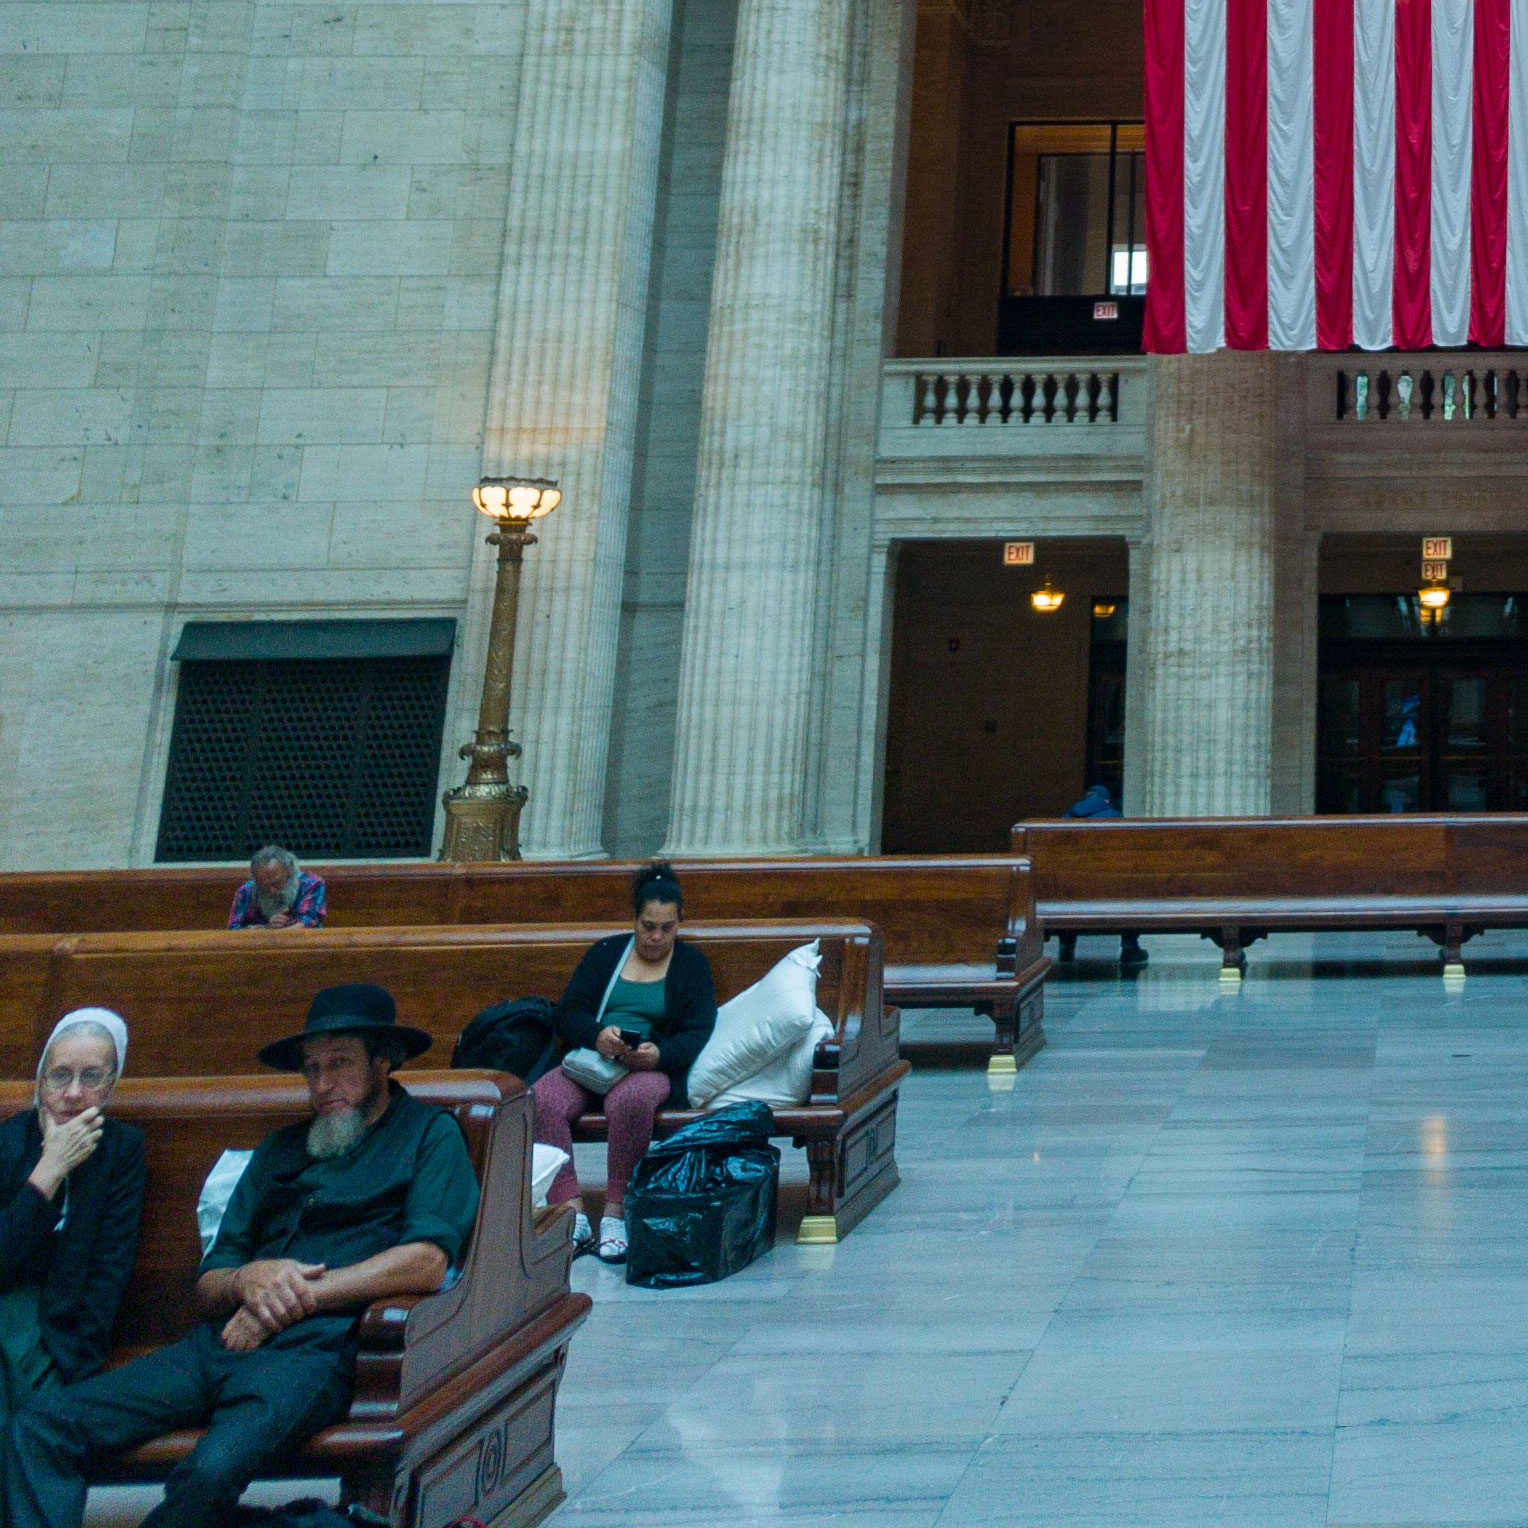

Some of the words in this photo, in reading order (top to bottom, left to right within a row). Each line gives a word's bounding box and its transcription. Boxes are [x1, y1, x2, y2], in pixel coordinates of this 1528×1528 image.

[1096, 304, 1117, 317] EXIT
[1008, 545, 1031, 561] EXIT
[1426, 540, 1448, 556] EXIT
[1425, 563, 1445, 577] EXIT
